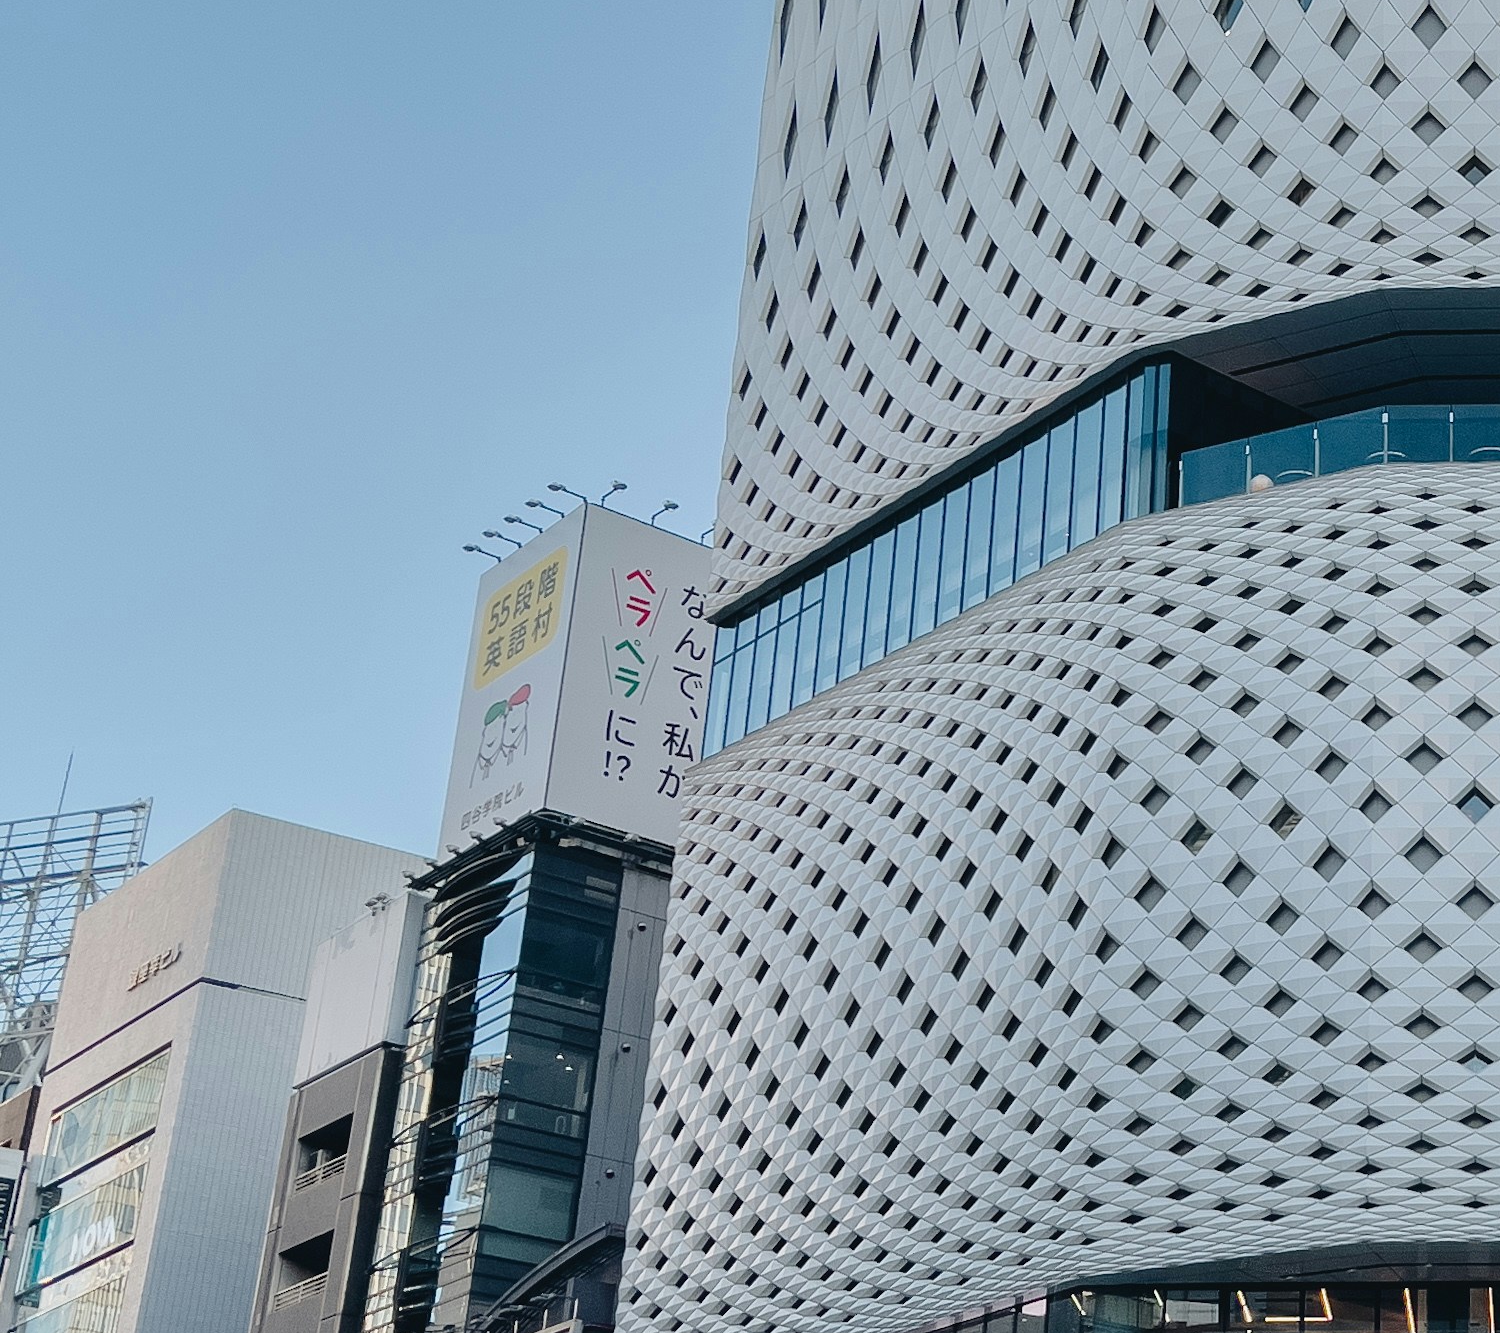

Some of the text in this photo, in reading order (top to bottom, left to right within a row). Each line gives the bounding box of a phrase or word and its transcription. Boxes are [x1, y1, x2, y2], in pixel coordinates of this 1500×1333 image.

[487, 561, 560, 634] 55段階
[483, 604, 552, 676] 英語村
